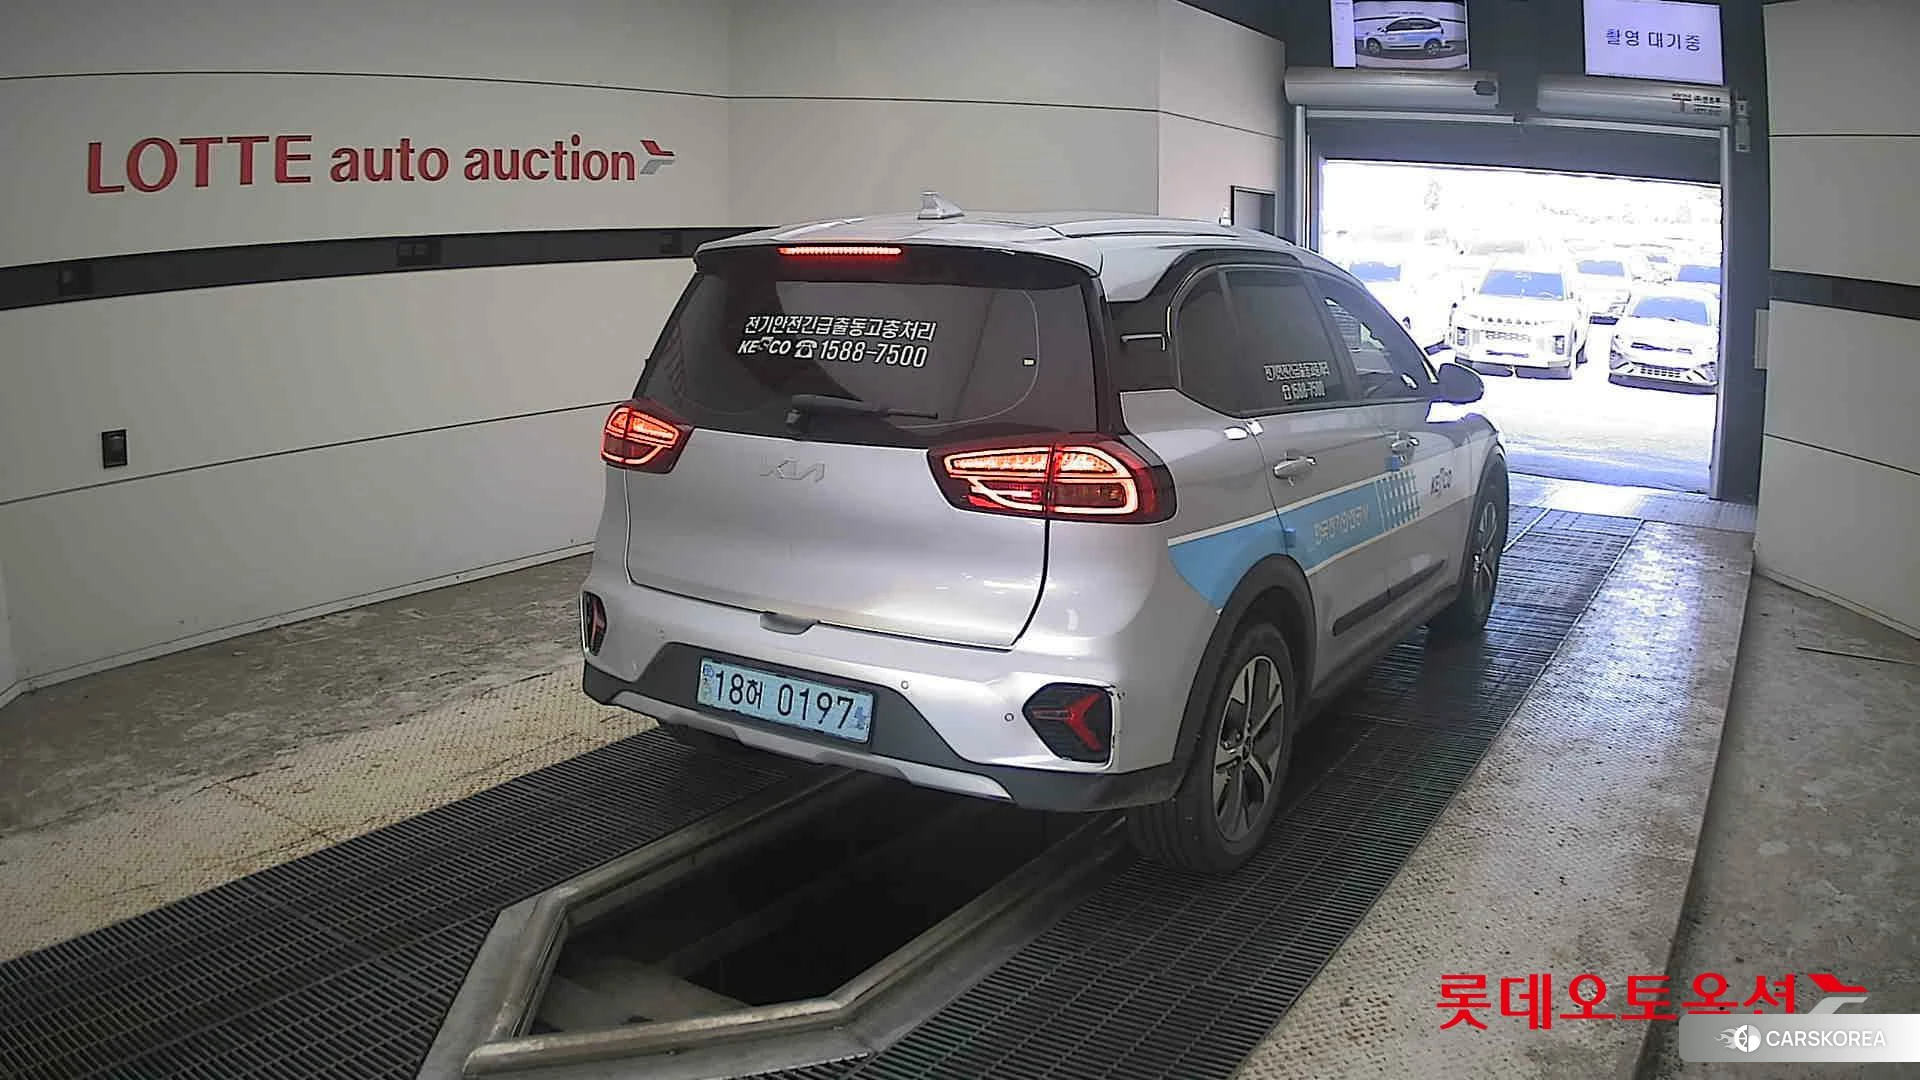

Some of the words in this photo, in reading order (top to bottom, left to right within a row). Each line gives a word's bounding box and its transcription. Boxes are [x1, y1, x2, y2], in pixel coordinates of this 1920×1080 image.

[1648, 31, 1701, 52] 대기중
[87, 134, 312, 194] LOTTE
[329, 138, 449, 182] auto
[463, 133, 636, 182] auction
[744, 315, 937, 342] 전기안전긴급출동고충처리
[819, 339, 928, 368] 1588-7500
[762, 456, 825, 484] KIA
[715, 670, 763, 710] 18허
[777, 683, 854, 729] 0197
